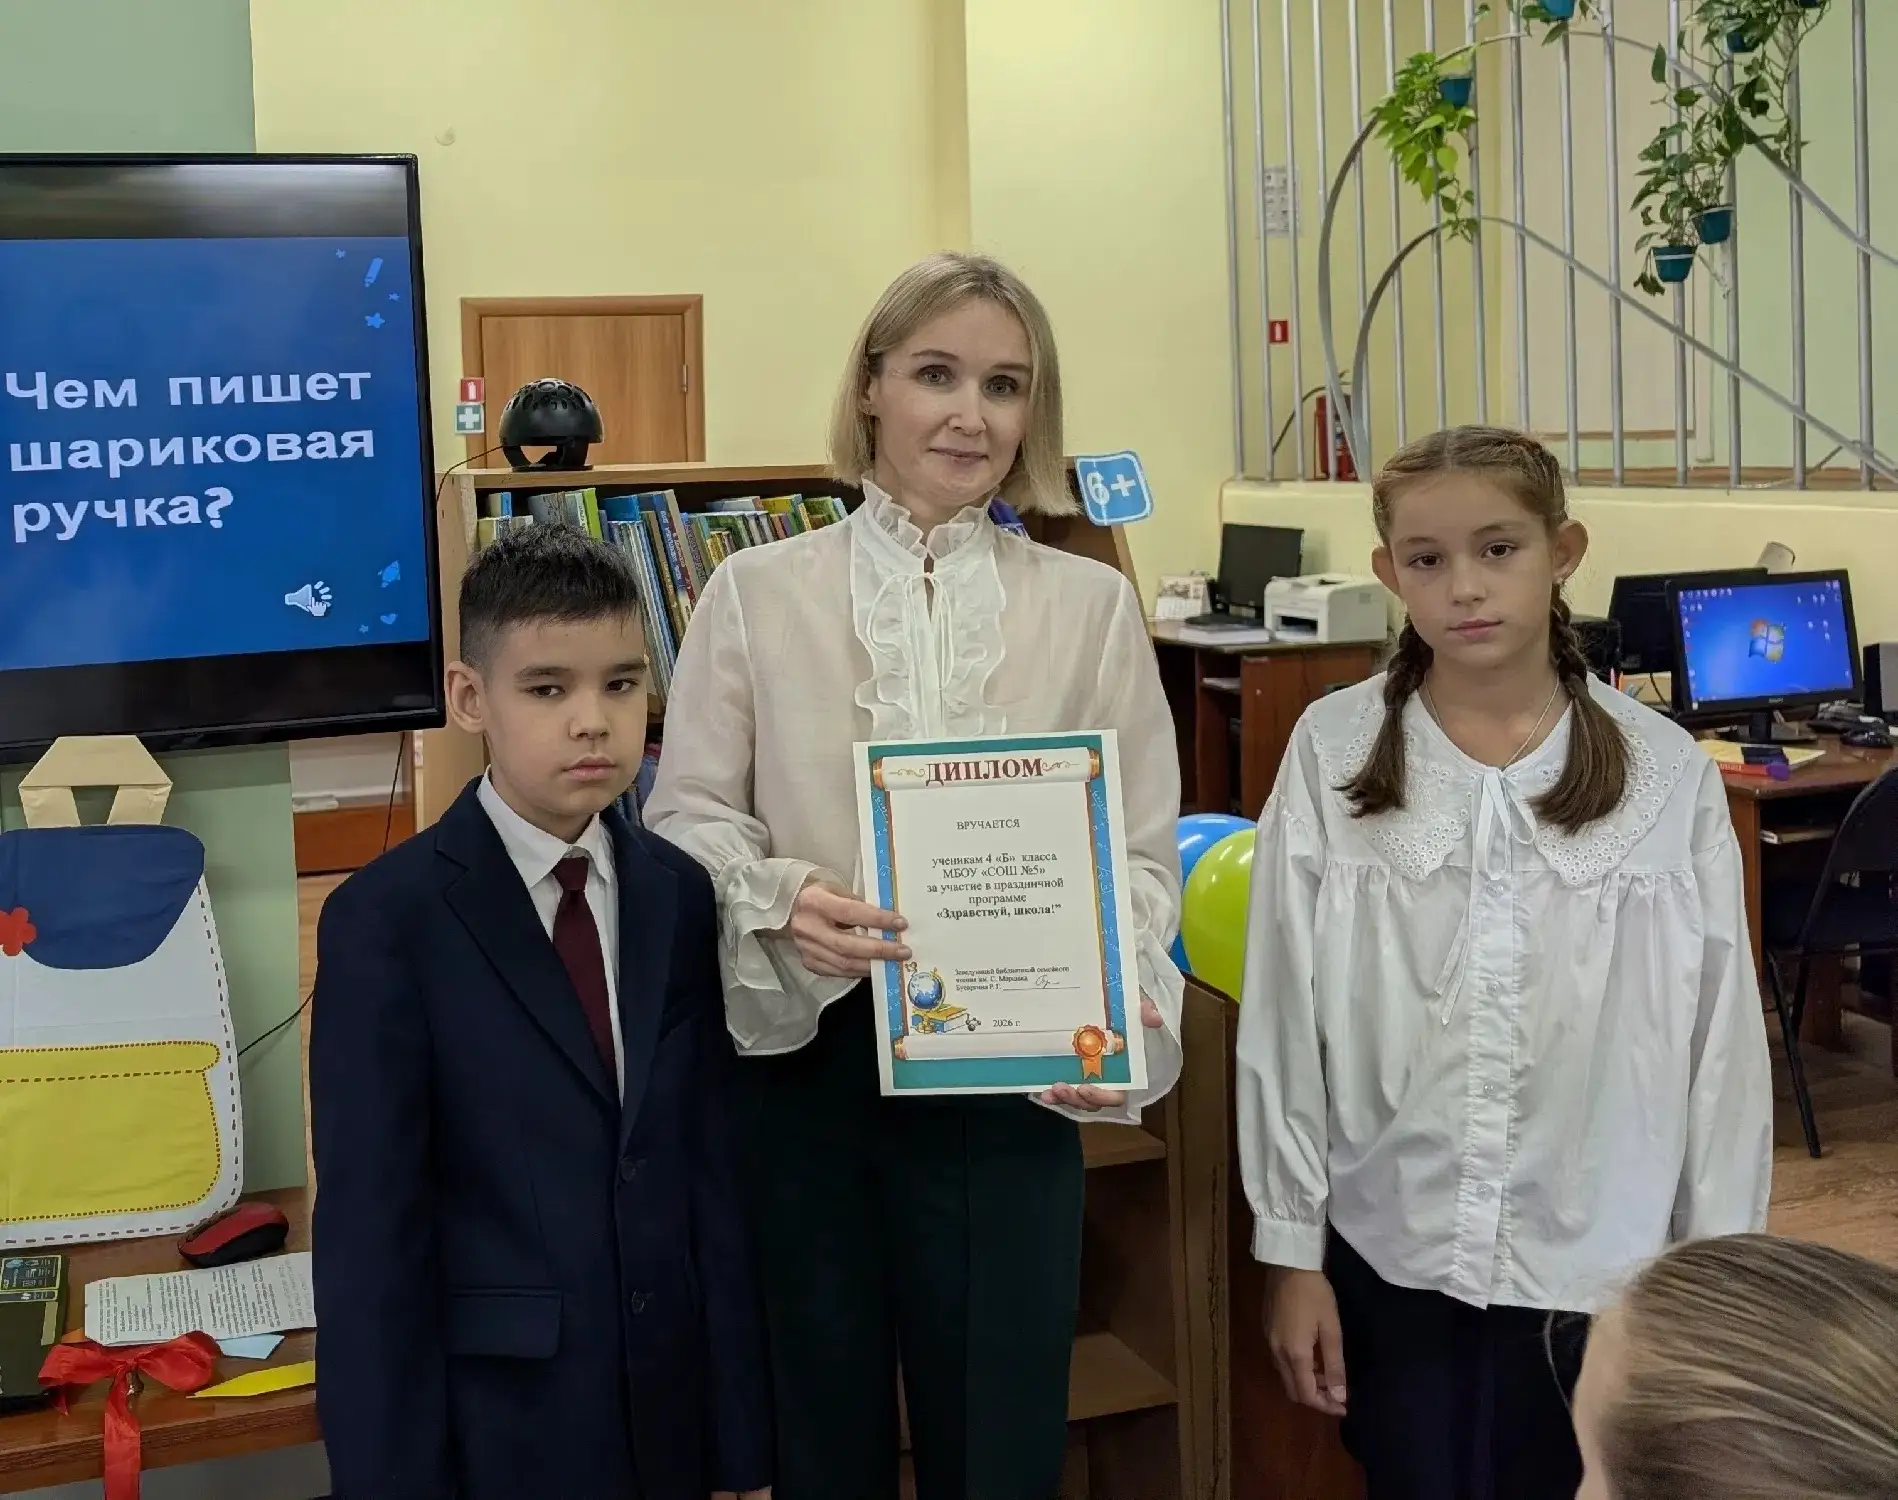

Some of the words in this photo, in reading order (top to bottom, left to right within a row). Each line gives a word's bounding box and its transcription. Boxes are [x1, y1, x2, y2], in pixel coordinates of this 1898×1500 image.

[6, 371, 138, 410] Чем
[168, 371, 372, 405] пишет
[10, 430, 374, 478] шариковая
[1086, 472, 1136, 505] 6+
[13, 486, 234, 543] ручка?
[925, 758, 1043, 787] ДИПЛОМ
[956, 819, 1021, 830] ВРУЧАЕТСЯ
[932, 855, 983, 868] ученикам
[985, 854, 992, 863] 4
[995, 853, 1015, 863] «Б»
[1021, 852, 1057, 862] класса
[943, 868, 977, 878] МБОУ
[981, 866, 1017, 876] «СОШ
[1020, 865, 1045, 876] №5»
[926, 885, 938, 893] за
[940, 882, 982, 894] участие
[985, 882, 991, 890] в
[994, 877, 1064, 892] праздничной
[968, 894, 1027, 906] программе
[937, 906, 1011, 920] «Здравствуй,
[993, 1019, 1013, 1028] 2026
